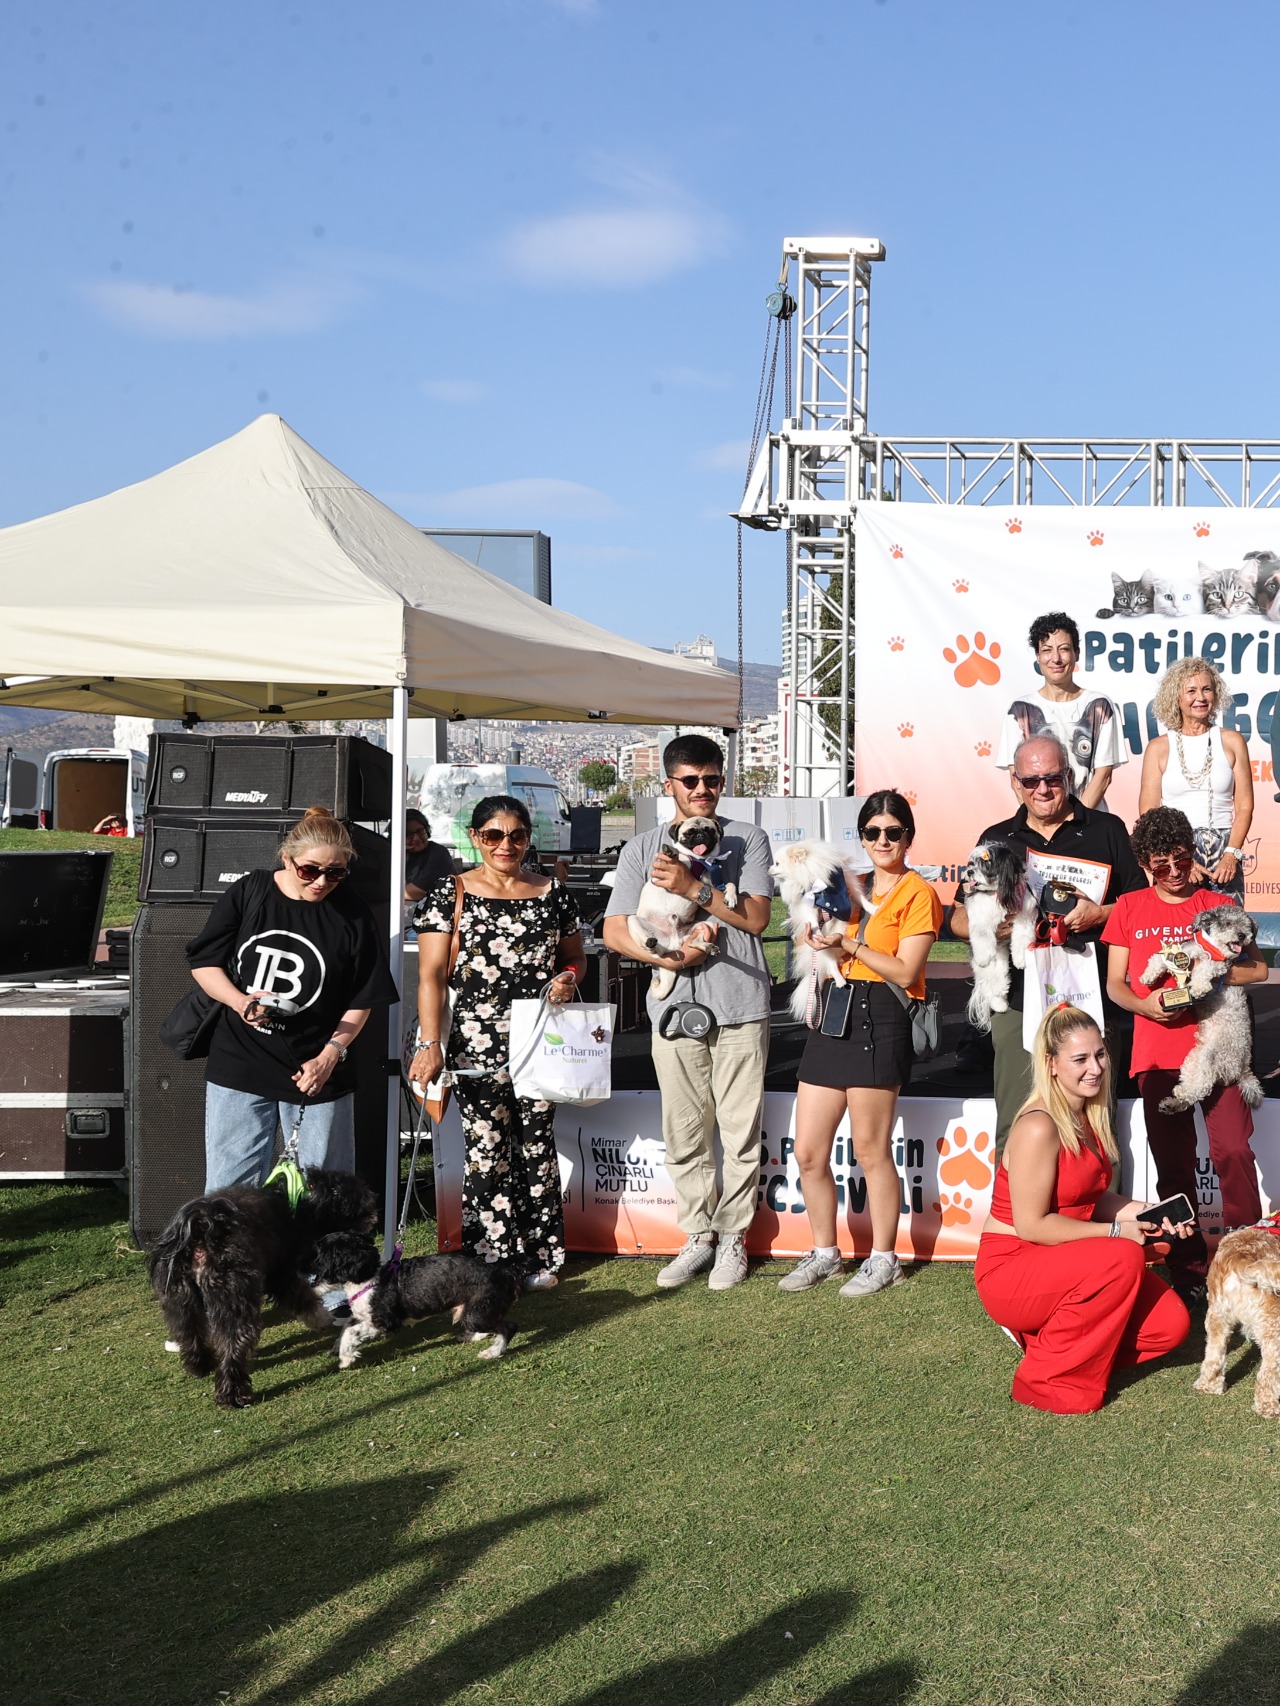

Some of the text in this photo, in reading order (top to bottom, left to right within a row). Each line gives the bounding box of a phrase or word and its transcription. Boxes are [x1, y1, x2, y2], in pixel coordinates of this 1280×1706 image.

[1135, 925, 1194, 940] GIVENC
[543, 1045, 558, 1056] Le
[591, 1137, 628, 1148] Mimar
[595, 1164, 655, 1180] ÇINARLI
[595, 1179, 649, 1193] MUTLU
[595, 1197, 619, 1205] Konak
[1198, 1210, 1220, 1219] ediye
